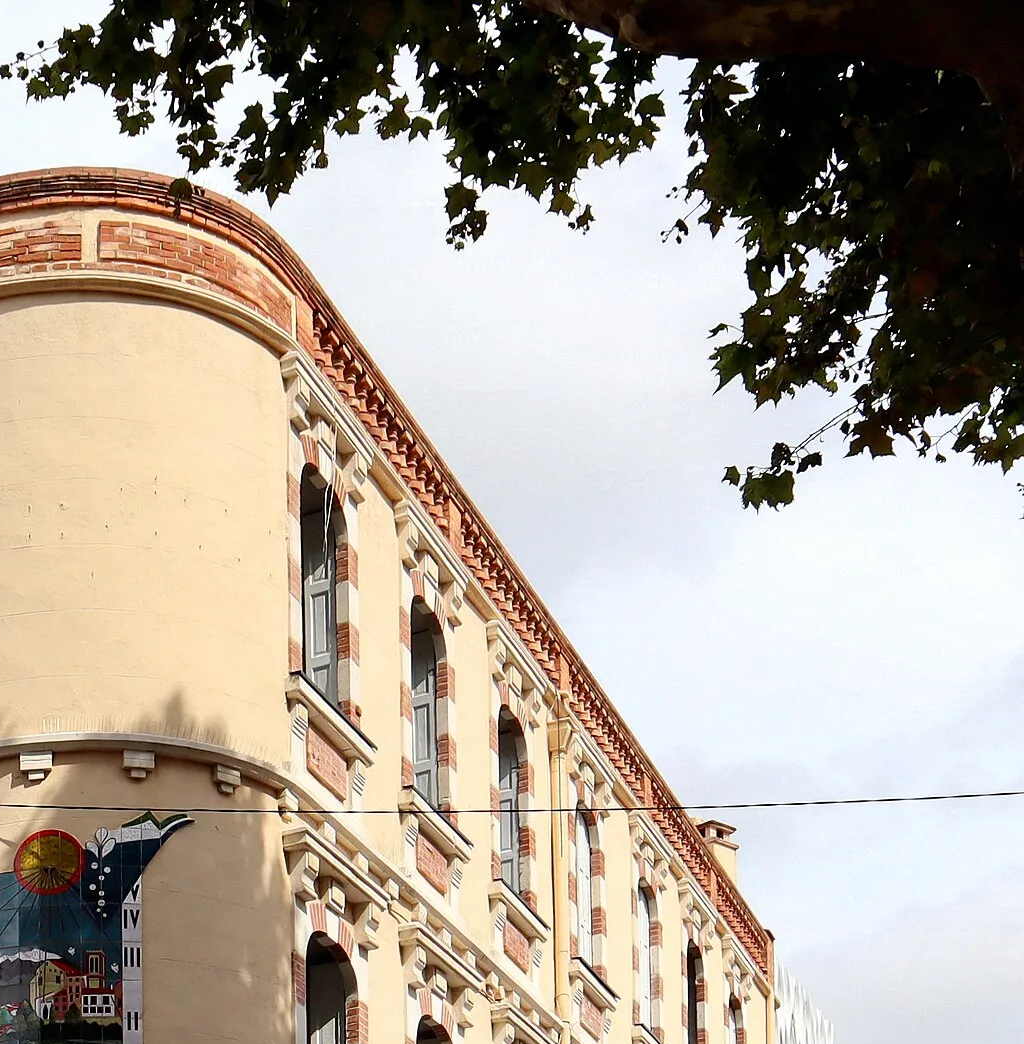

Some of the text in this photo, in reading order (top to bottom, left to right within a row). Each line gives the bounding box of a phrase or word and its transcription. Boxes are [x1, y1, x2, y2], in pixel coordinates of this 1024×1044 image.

[123, 909, 140, 929] IV
[123, 947, 141, 967] III
[127, 1011, 139, 1031] II
